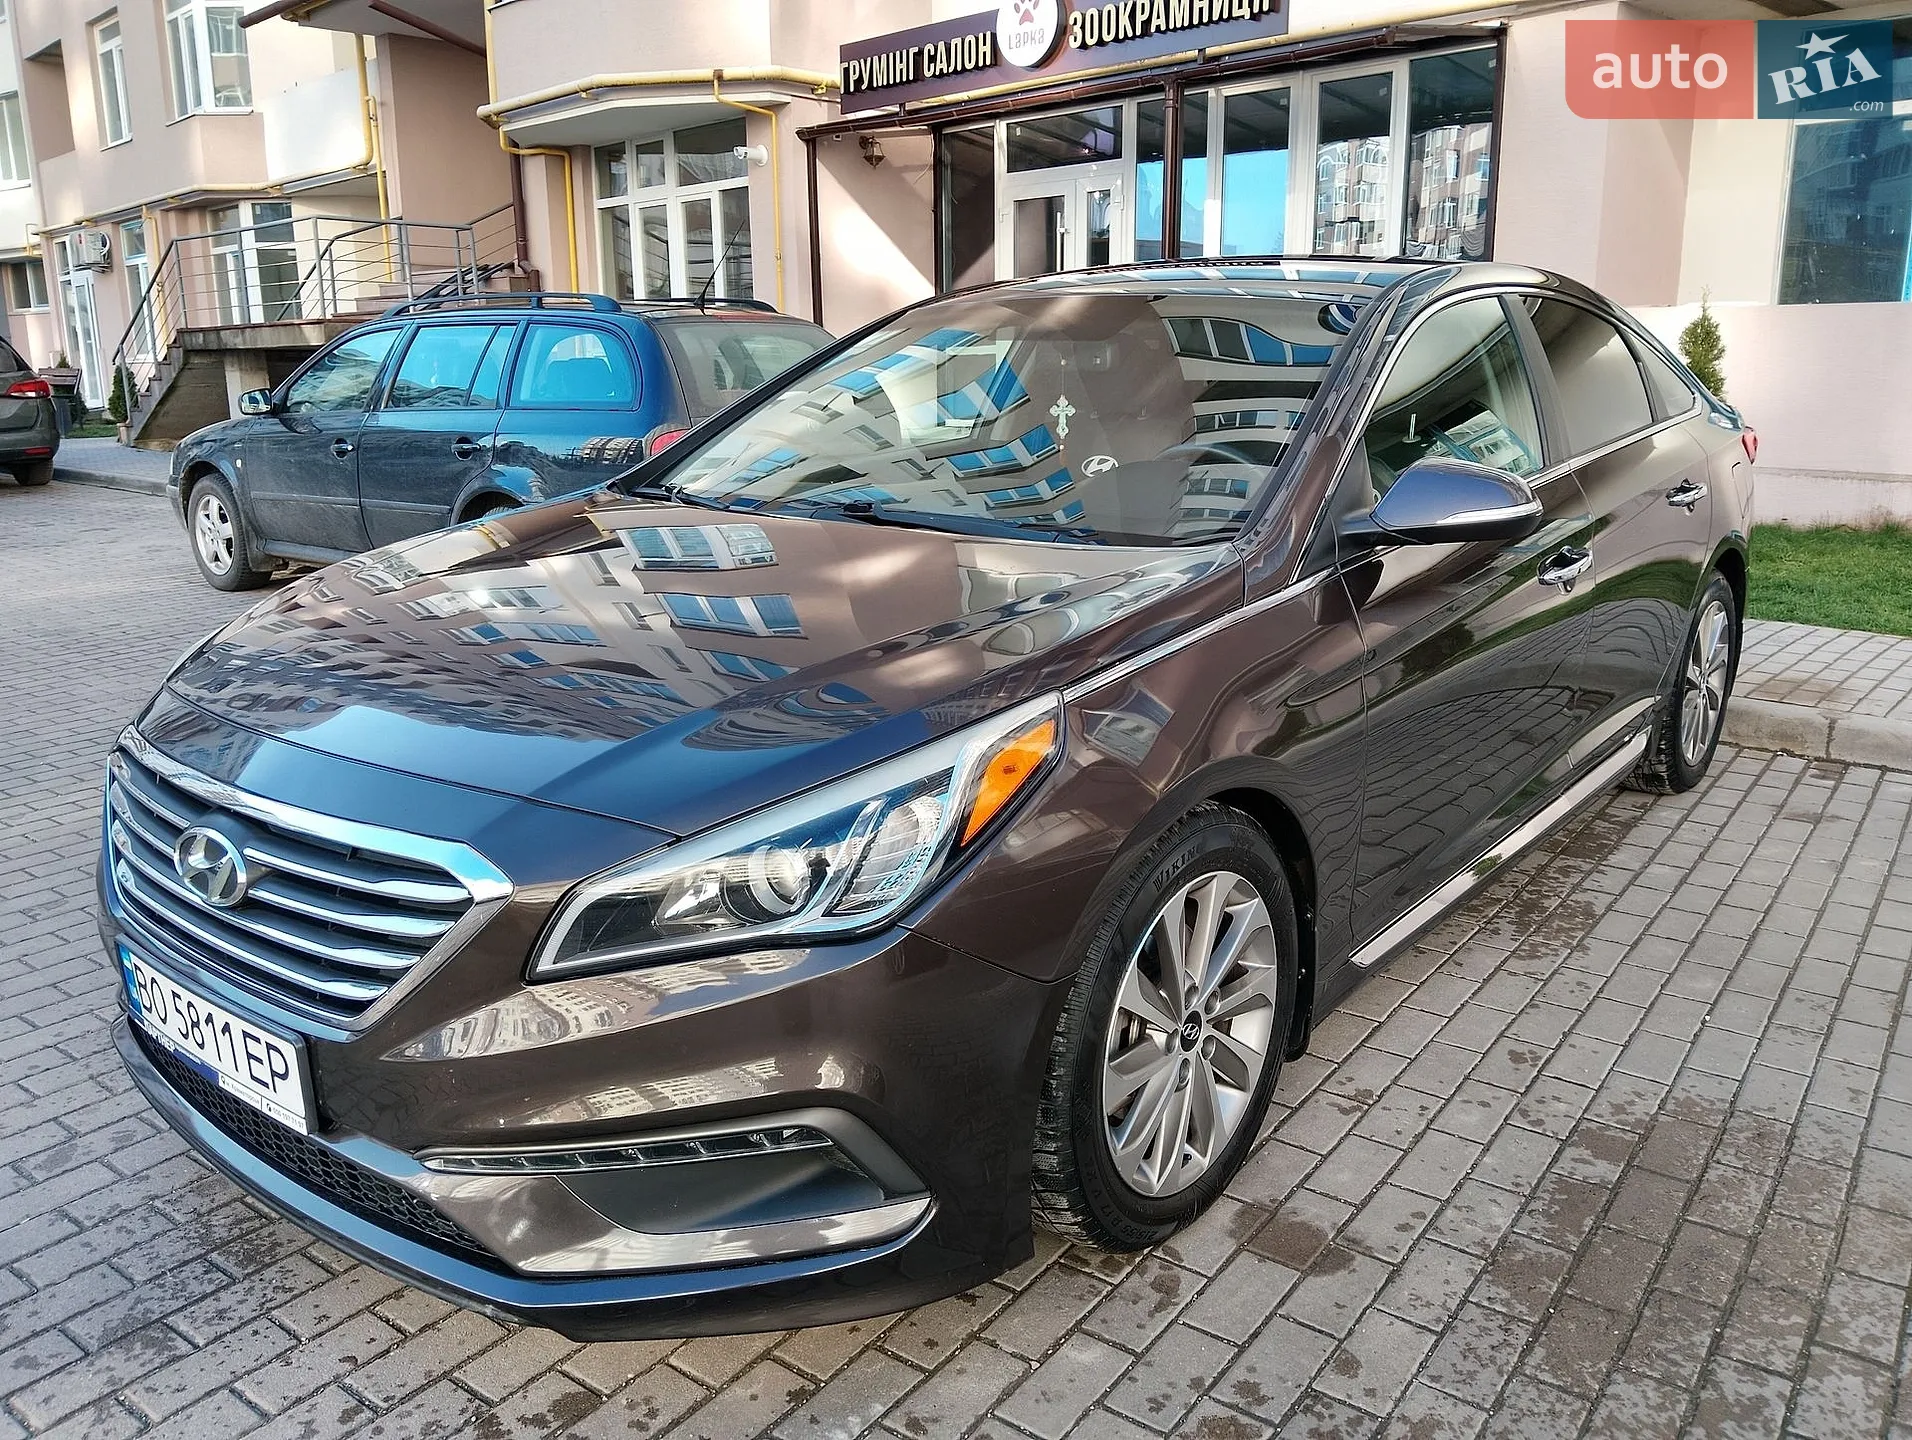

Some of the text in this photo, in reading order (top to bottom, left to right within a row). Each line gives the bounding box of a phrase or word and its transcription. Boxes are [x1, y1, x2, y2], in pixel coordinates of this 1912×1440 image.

[840, 30, 992, 95] ГРУМІНГ САЛОН
[133, 962, 168, 1025] BO
[170, 989, 240, 1073] 5811
[243, 1028, 290, 1094] EP
